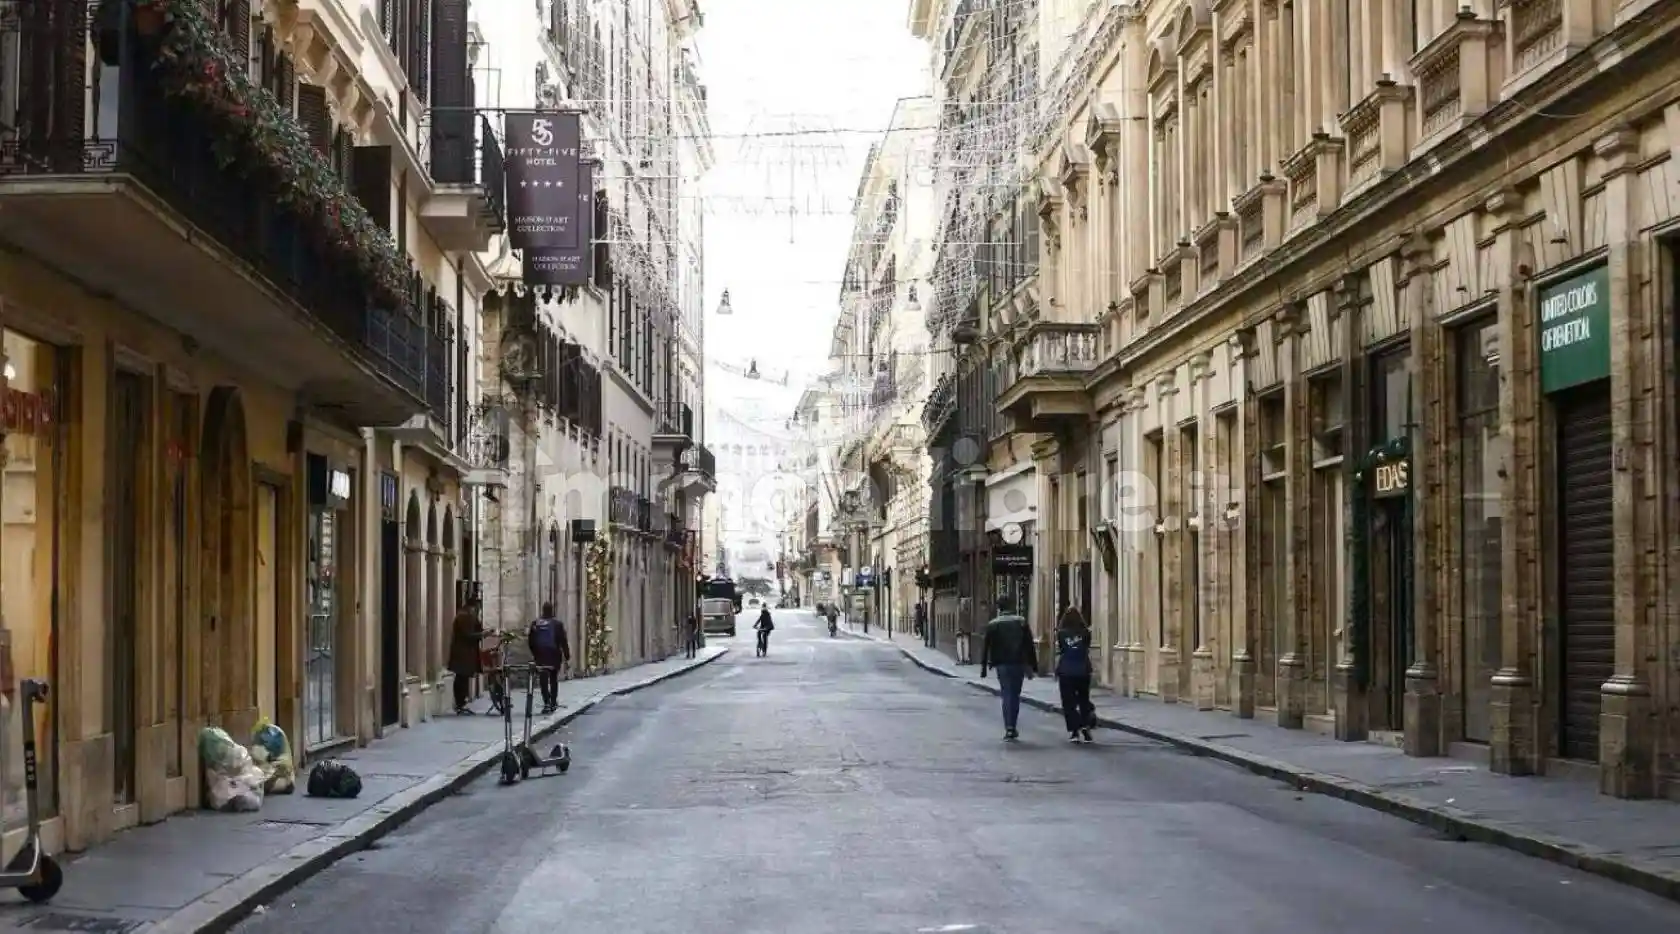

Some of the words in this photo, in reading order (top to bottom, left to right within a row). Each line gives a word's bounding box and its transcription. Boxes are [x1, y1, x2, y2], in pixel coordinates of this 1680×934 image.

[507, 147, 576, 157] FIFTY-FIVE
[526, 158, 557, 166] HOTEL
[1541, 293, 1567, 322] UNITED
[1568, 281, 1597, 313] COLORS
[1542, 328, 1553, 352] OF
[1553, 315, 1591, 349] BENETTON
[1376, 460, 1407, 491] EDAS
